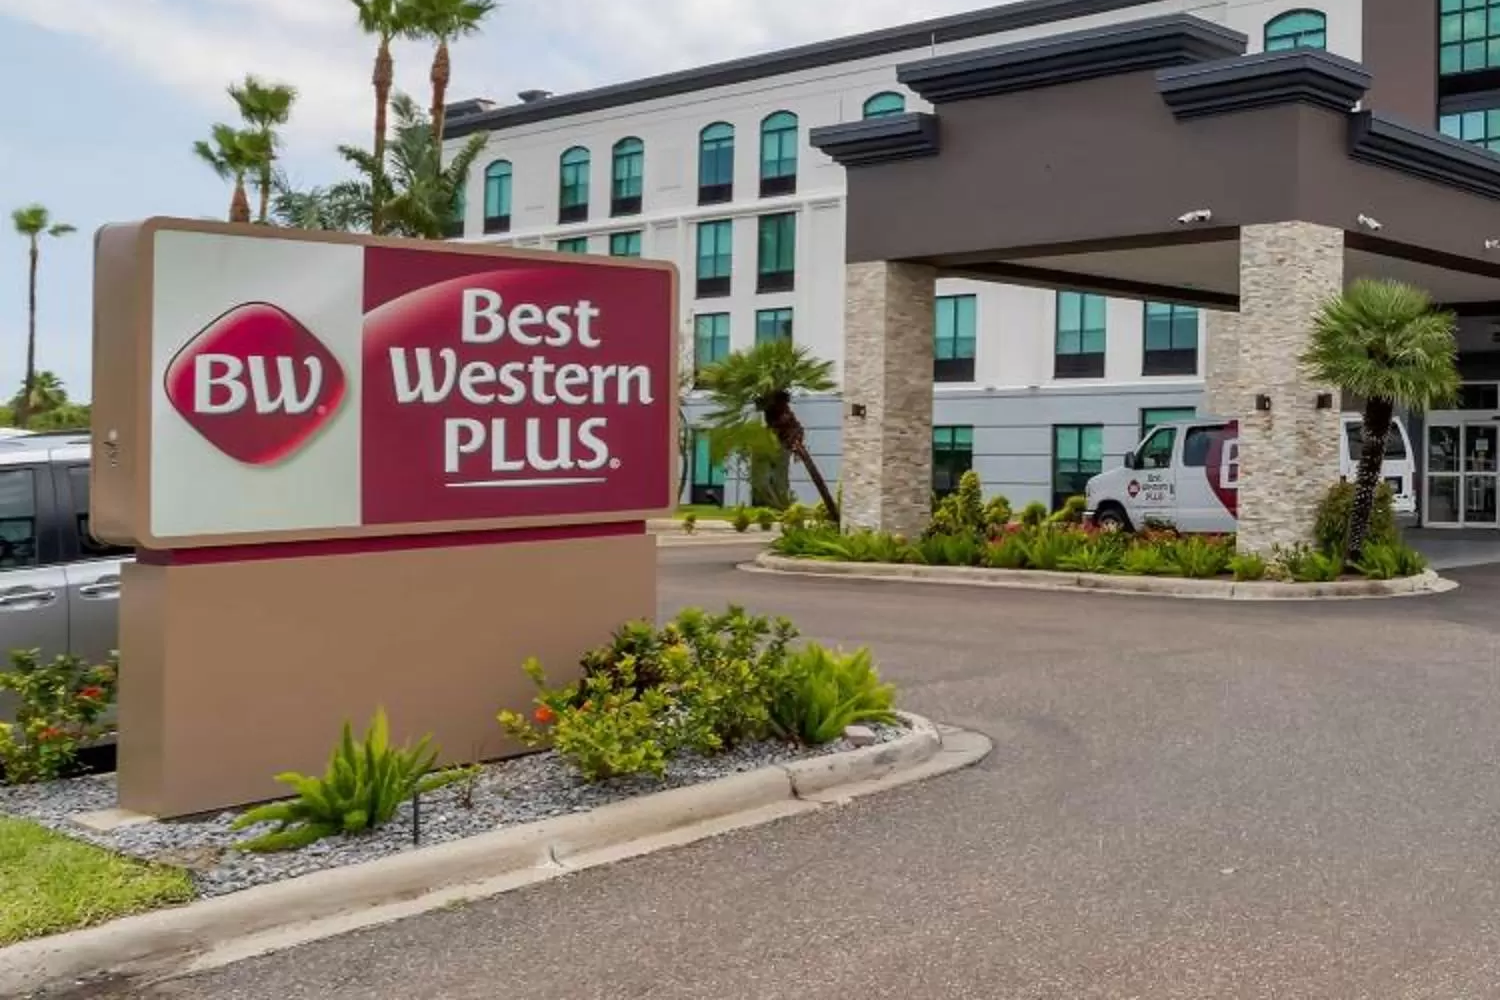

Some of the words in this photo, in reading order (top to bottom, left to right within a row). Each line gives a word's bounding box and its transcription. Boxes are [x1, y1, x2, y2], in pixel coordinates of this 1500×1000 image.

[461, 287, 601, 348] Best
[194, 353, 324, 415] BW
[389, 346, 655, 405] Western
[444, 417, 610, 473] PLUS
